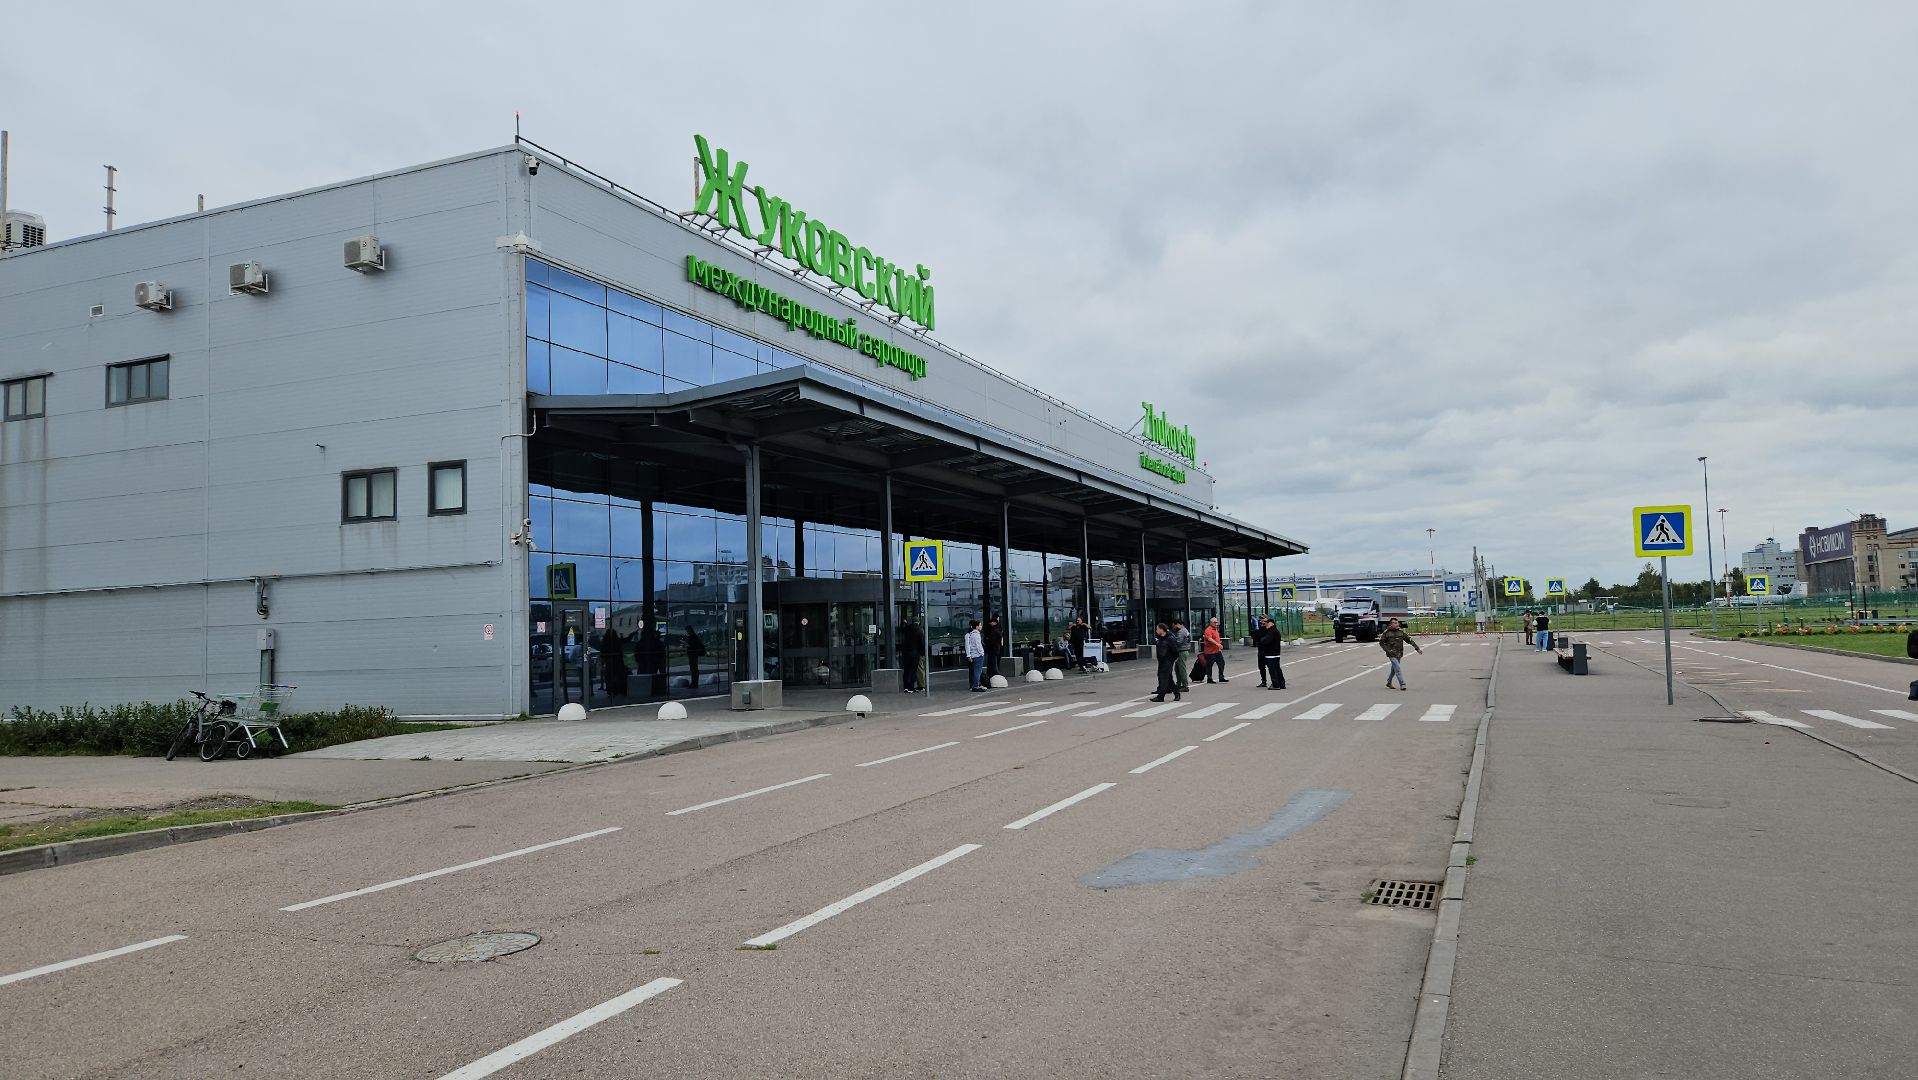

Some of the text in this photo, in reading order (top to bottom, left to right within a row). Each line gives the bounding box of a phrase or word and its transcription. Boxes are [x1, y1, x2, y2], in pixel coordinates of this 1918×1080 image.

[694, 134, 935, 331] ЖУКОВСКИЙ
[687, 255, 928, 381] международный аэропорт
